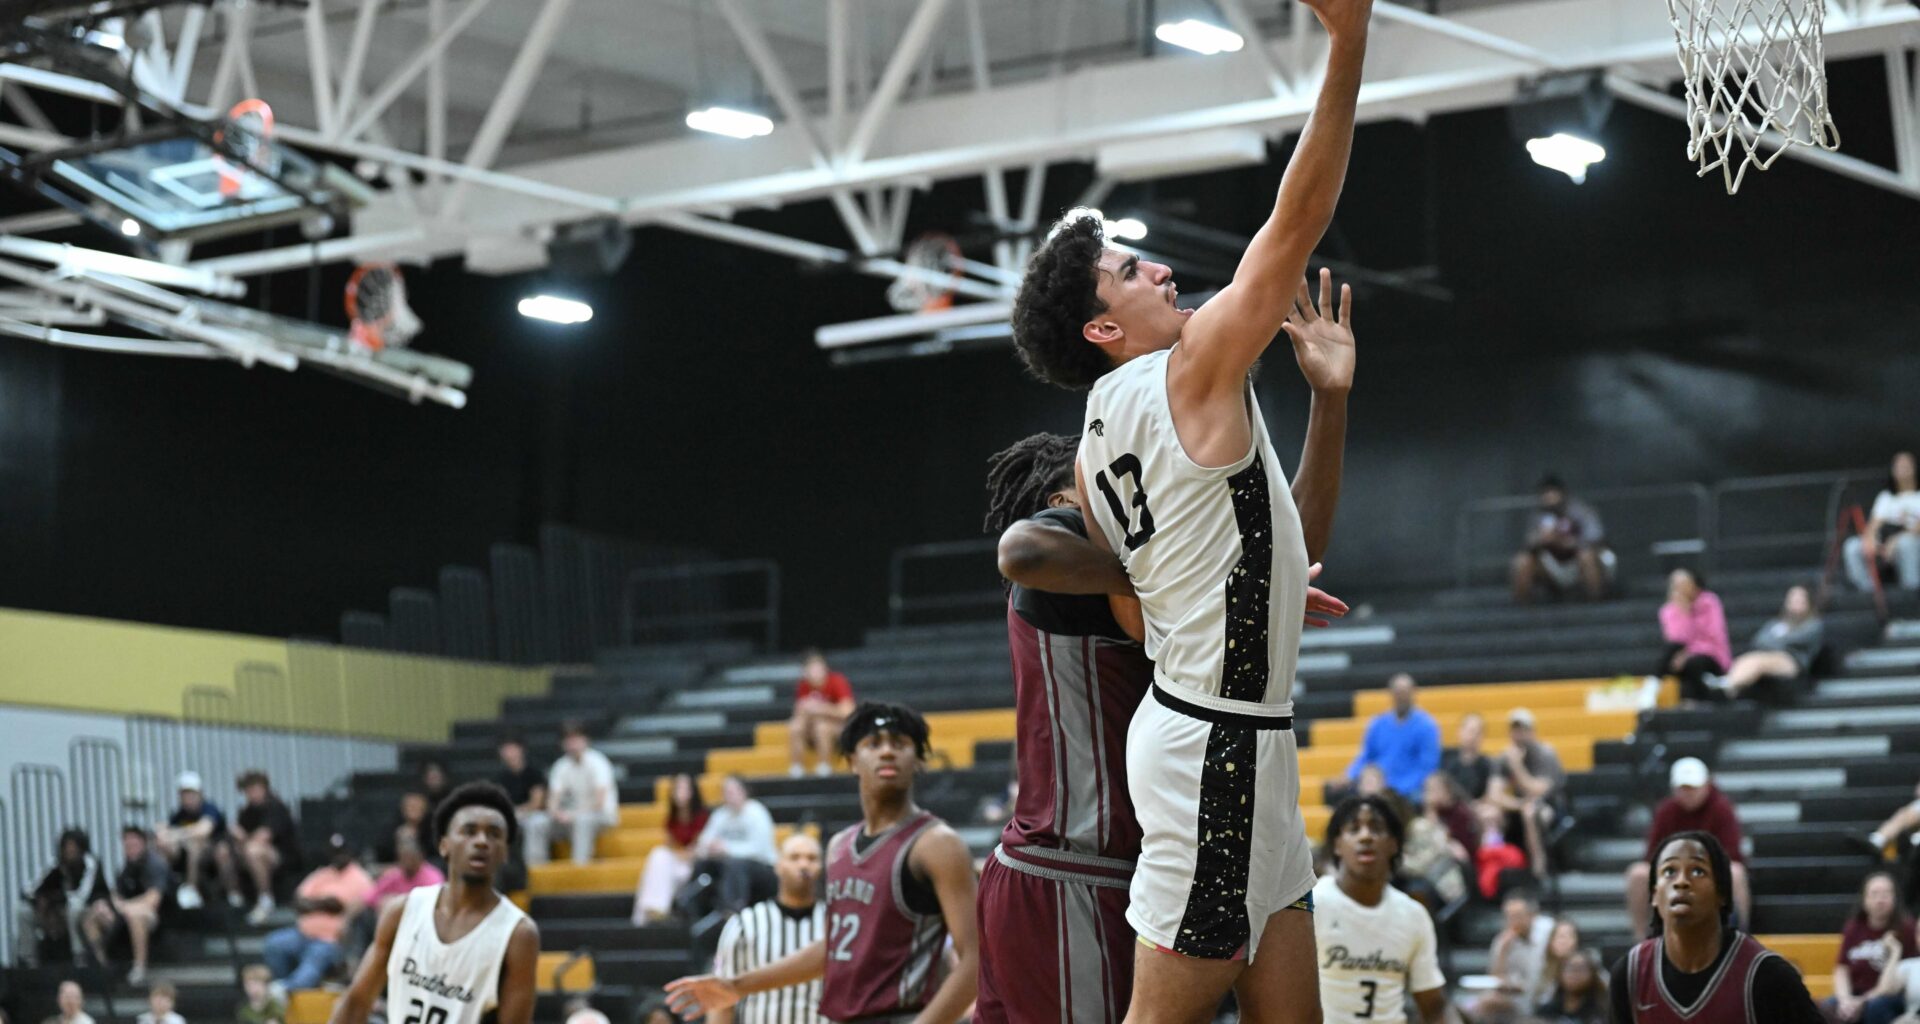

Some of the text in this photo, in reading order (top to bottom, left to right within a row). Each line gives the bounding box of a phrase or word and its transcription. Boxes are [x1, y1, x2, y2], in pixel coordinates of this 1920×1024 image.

[1096, 453, 1156, 552] 13
[402, 957, 474, 1003] Panthers
[1354, 980, 1377, 1018] 3
